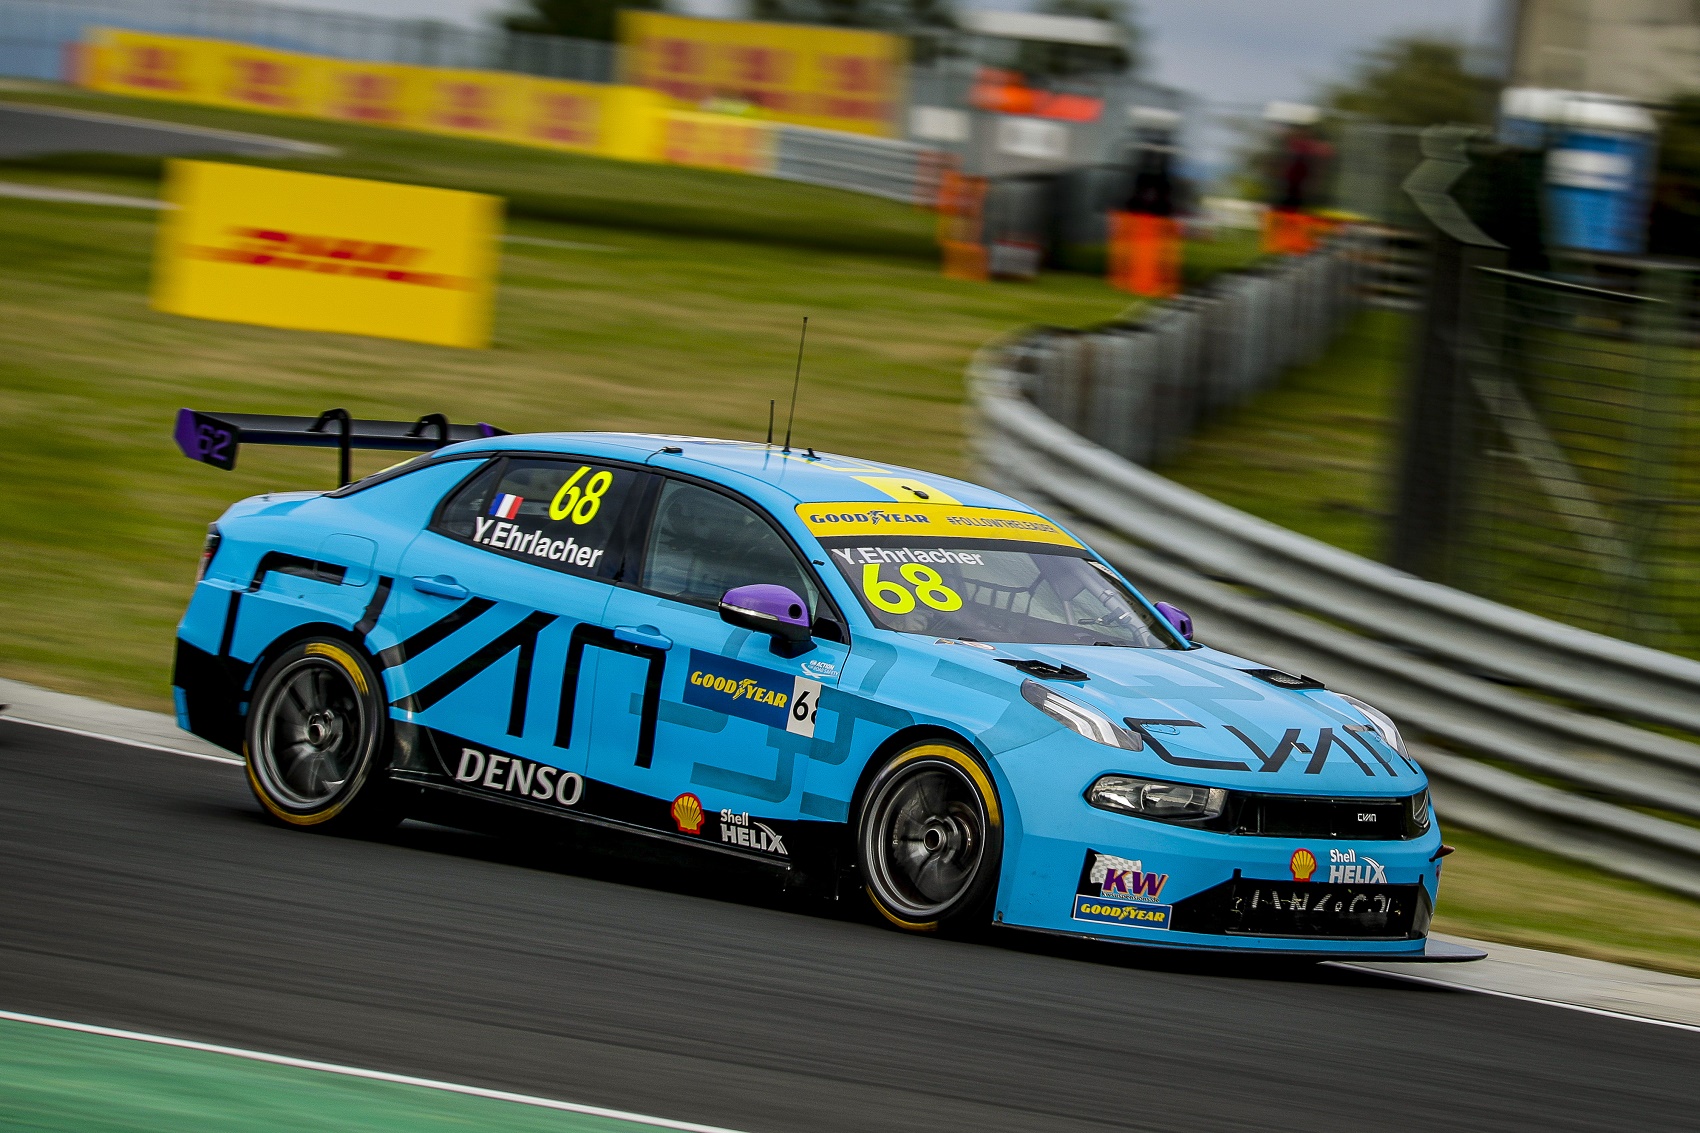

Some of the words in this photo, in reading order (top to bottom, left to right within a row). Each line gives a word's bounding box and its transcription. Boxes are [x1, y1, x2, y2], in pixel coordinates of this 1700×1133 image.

[197, 424, 231, 460] 62
[549, 466, 613, 525] 68
[473, 516, 603, 568] Y.Ehrlacher
[831, 547, 984, 566] Y.Ehrlacher
[862, 563, 963, 614] 68
[455, 747, 584, 806] DENSO
[720, 808, 749, 827] Shell
[720, 822, 788, 855] HELIX
[1329, 848, 1356, 863] Shell
[1102, 868, 1169, 897] KW
[1329, 861, 1387, 884] HELIX
